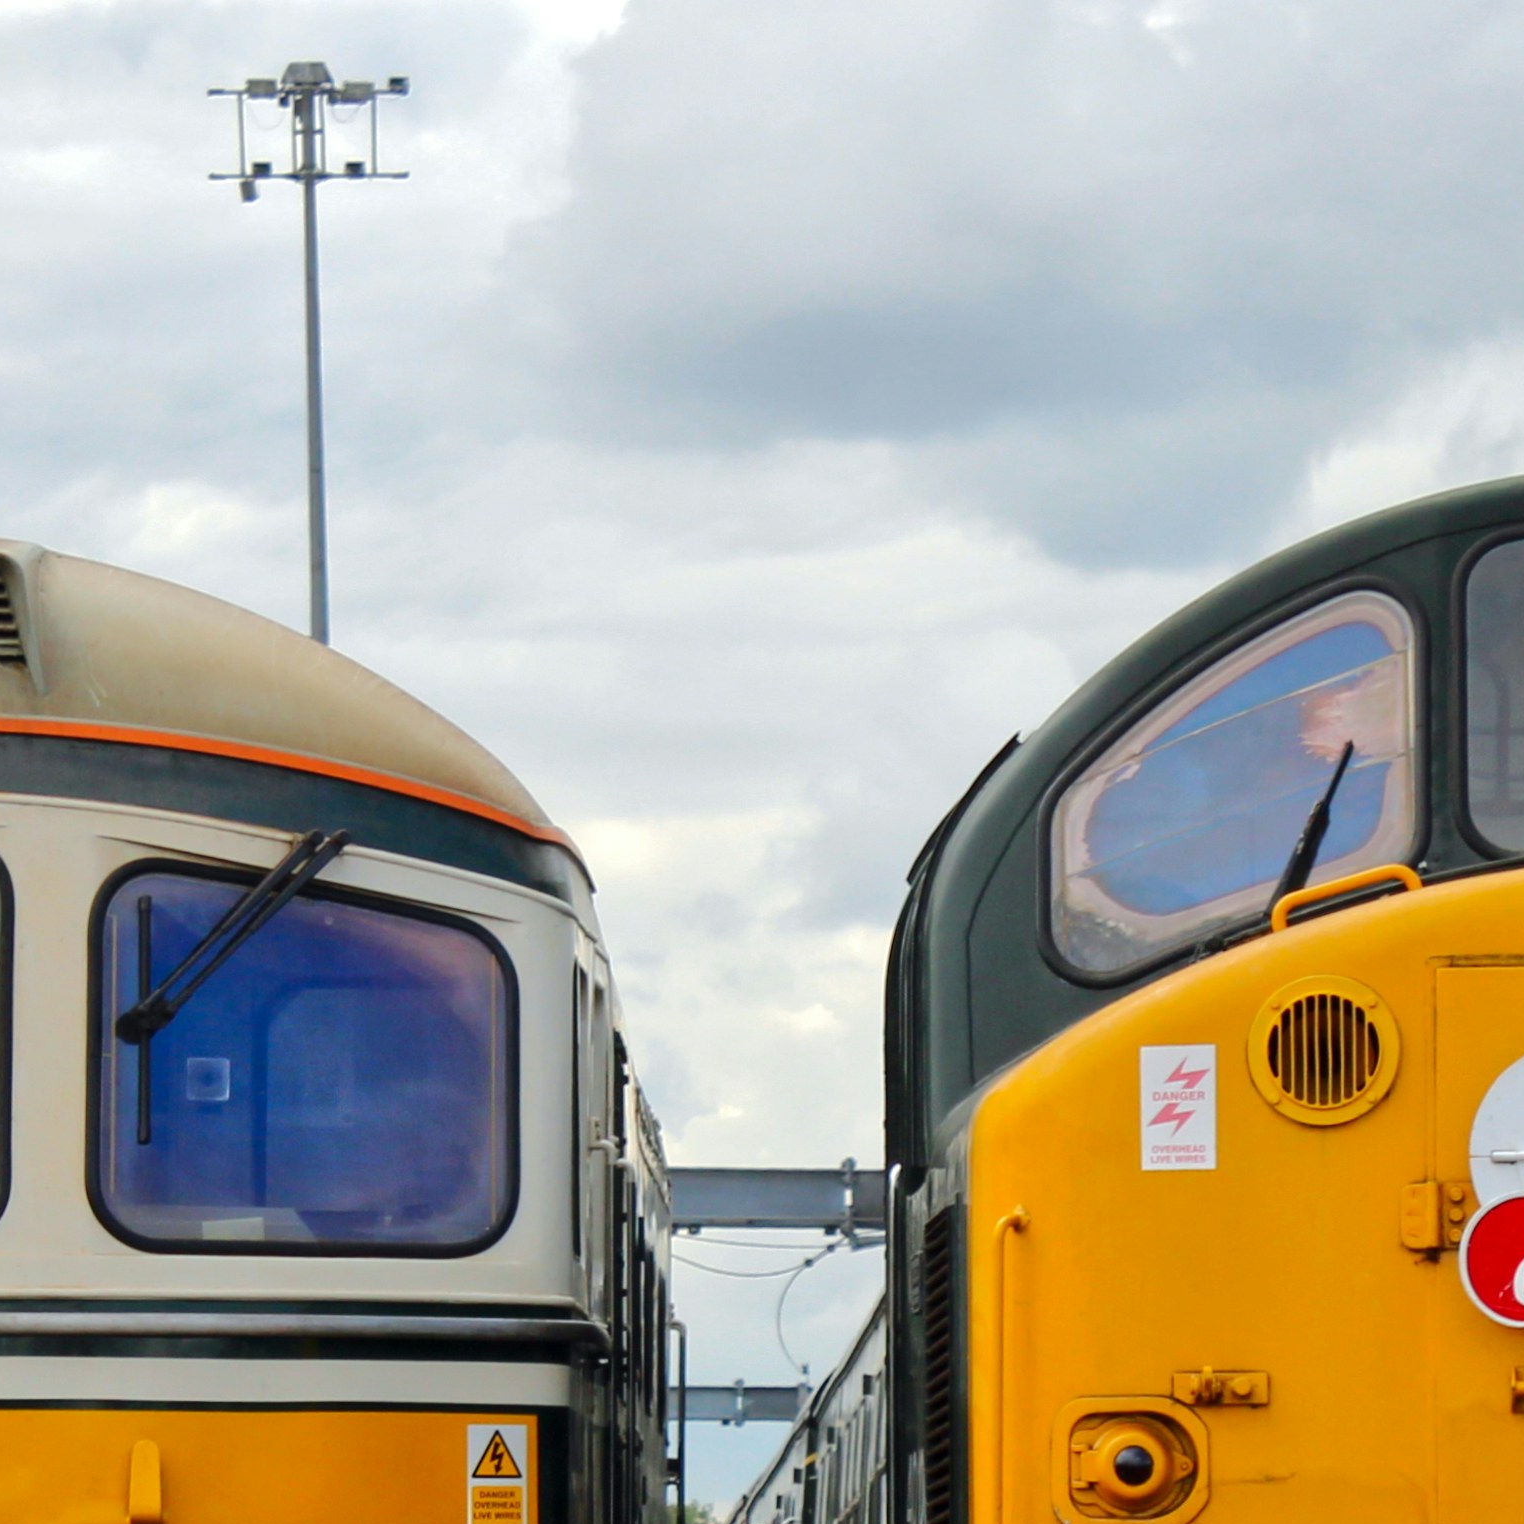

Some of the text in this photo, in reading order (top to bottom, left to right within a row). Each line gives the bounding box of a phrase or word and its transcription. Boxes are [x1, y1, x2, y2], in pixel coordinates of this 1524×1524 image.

[1152, 1091, 1205, 1101] DANGER
[1151, 1145, 1206, 1154] OVERHEAD
[1151, 1155, 1206, 1164] LIVE WIRES
[479, 1491, 515, 1499] DANGER
[474, 1501, 521, 1509] OVERHEAD
[473, 1512, 522, 1520] LIVE WIRES
